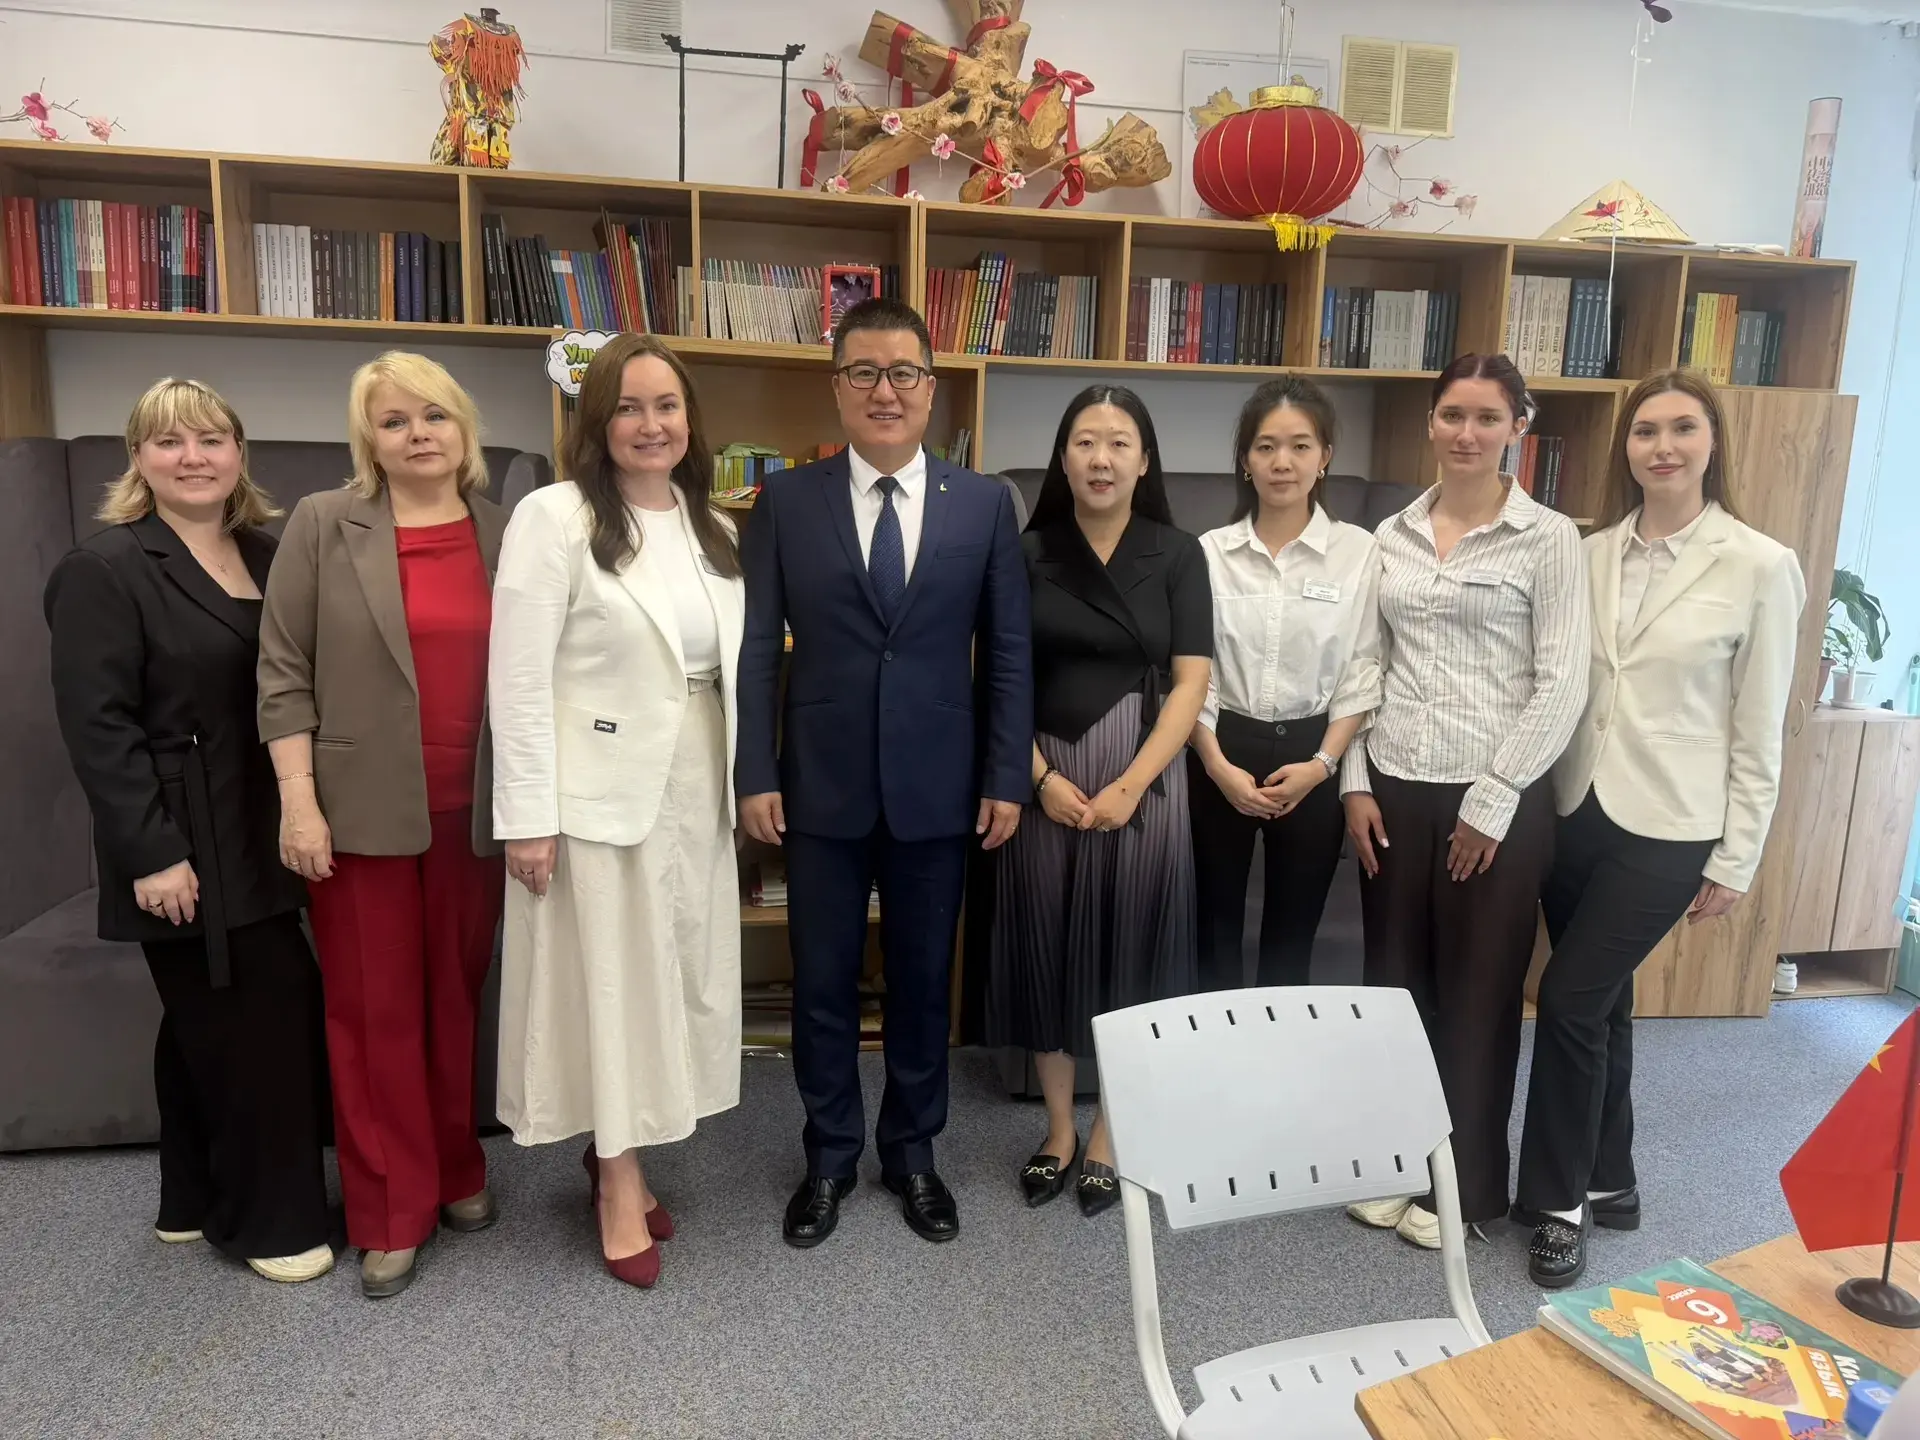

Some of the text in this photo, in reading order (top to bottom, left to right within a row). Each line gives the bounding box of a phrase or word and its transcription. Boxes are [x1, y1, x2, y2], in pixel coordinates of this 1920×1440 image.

[1536, 357, 1547, 371] 2
[1551, 358, 1561, 372] 2
[1807, 1350, 1846, 1401] ЯЗЫК
[1832, 1354, 1861, 1386] КИ
